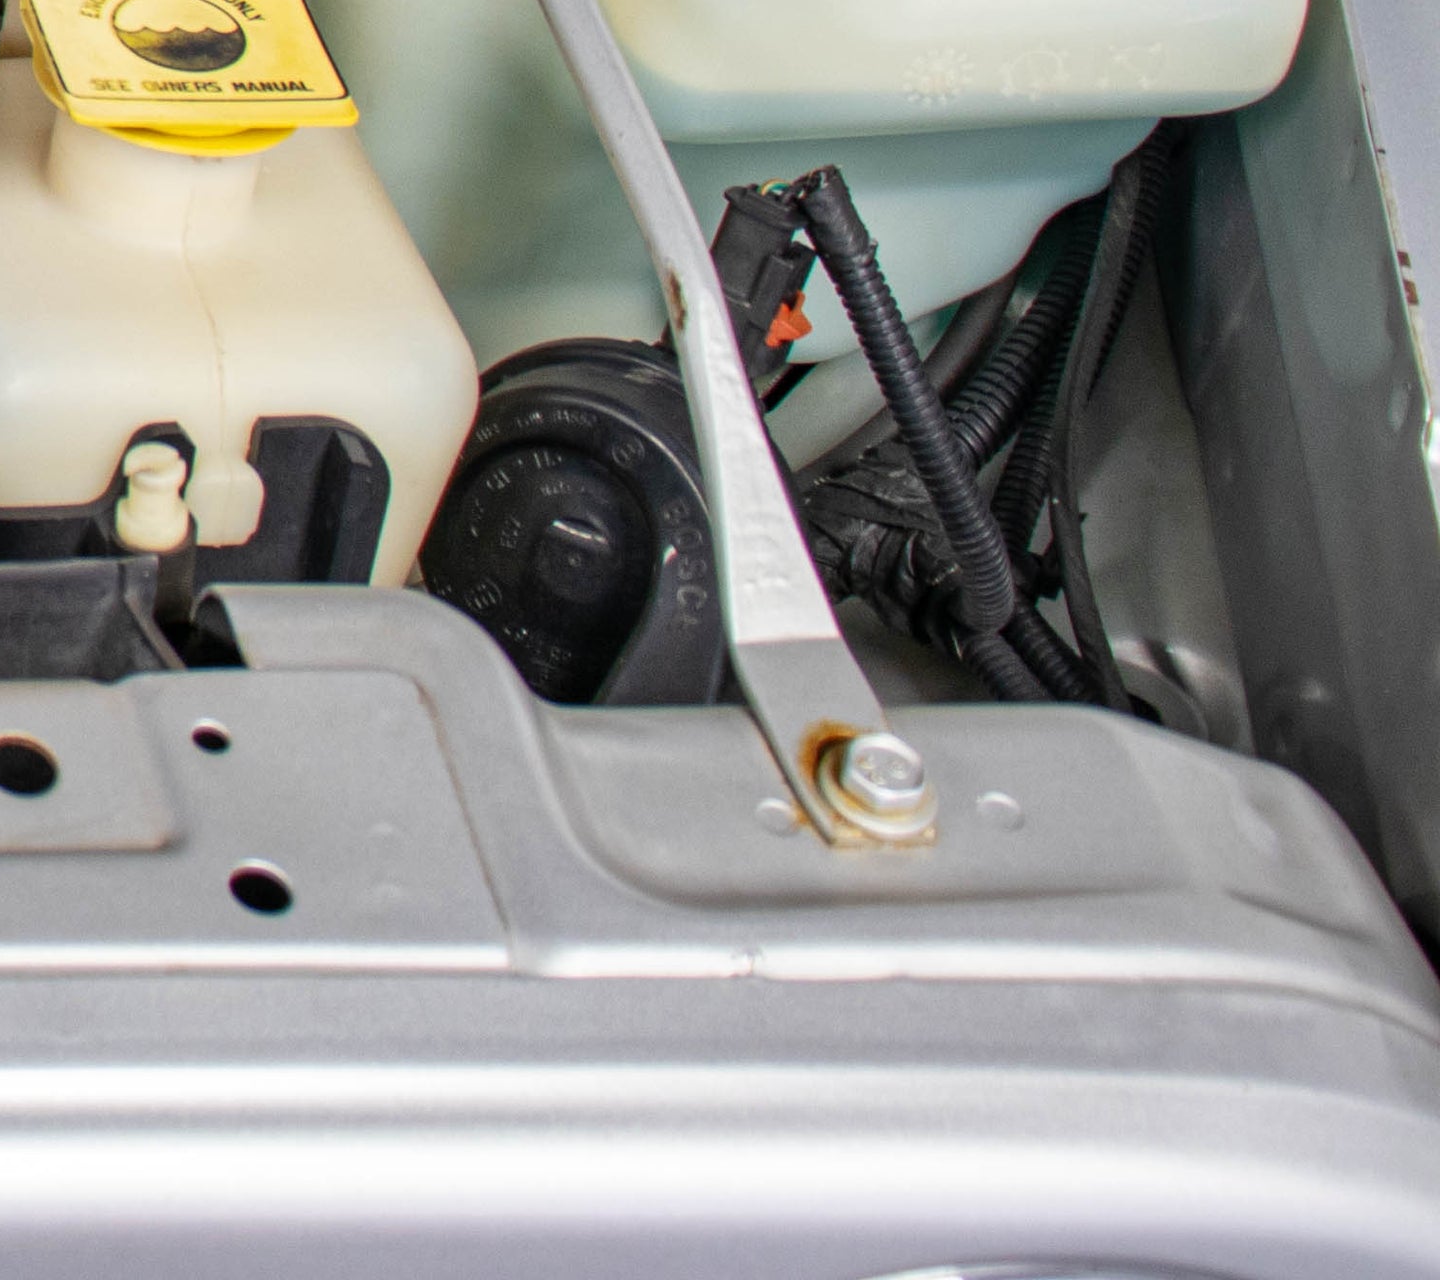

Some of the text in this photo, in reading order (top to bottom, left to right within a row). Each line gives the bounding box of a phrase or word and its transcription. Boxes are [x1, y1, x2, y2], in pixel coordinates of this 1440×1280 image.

[91, 78, 314, 92] SEE OWNERS MANUAL
